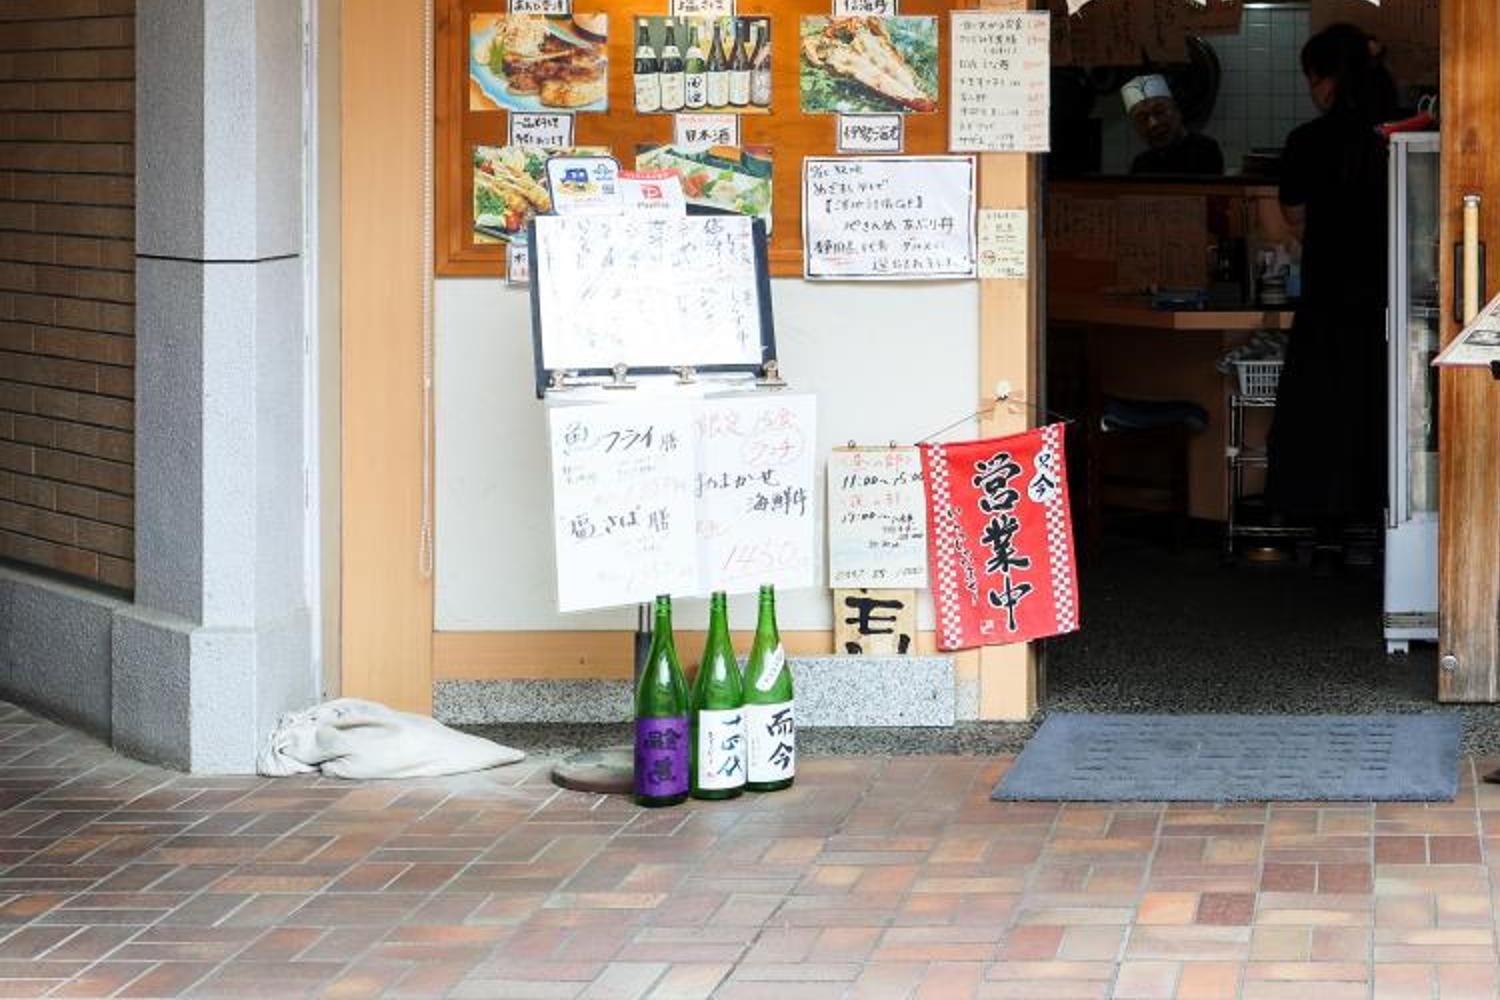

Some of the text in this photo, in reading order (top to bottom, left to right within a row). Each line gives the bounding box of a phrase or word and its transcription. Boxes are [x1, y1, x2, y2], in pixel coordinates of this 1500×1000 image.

[685, 128, 730, 145] 日本酒
[972, 452, 1033, 631] 営業中
[766, 707, 794, 770] 而今
